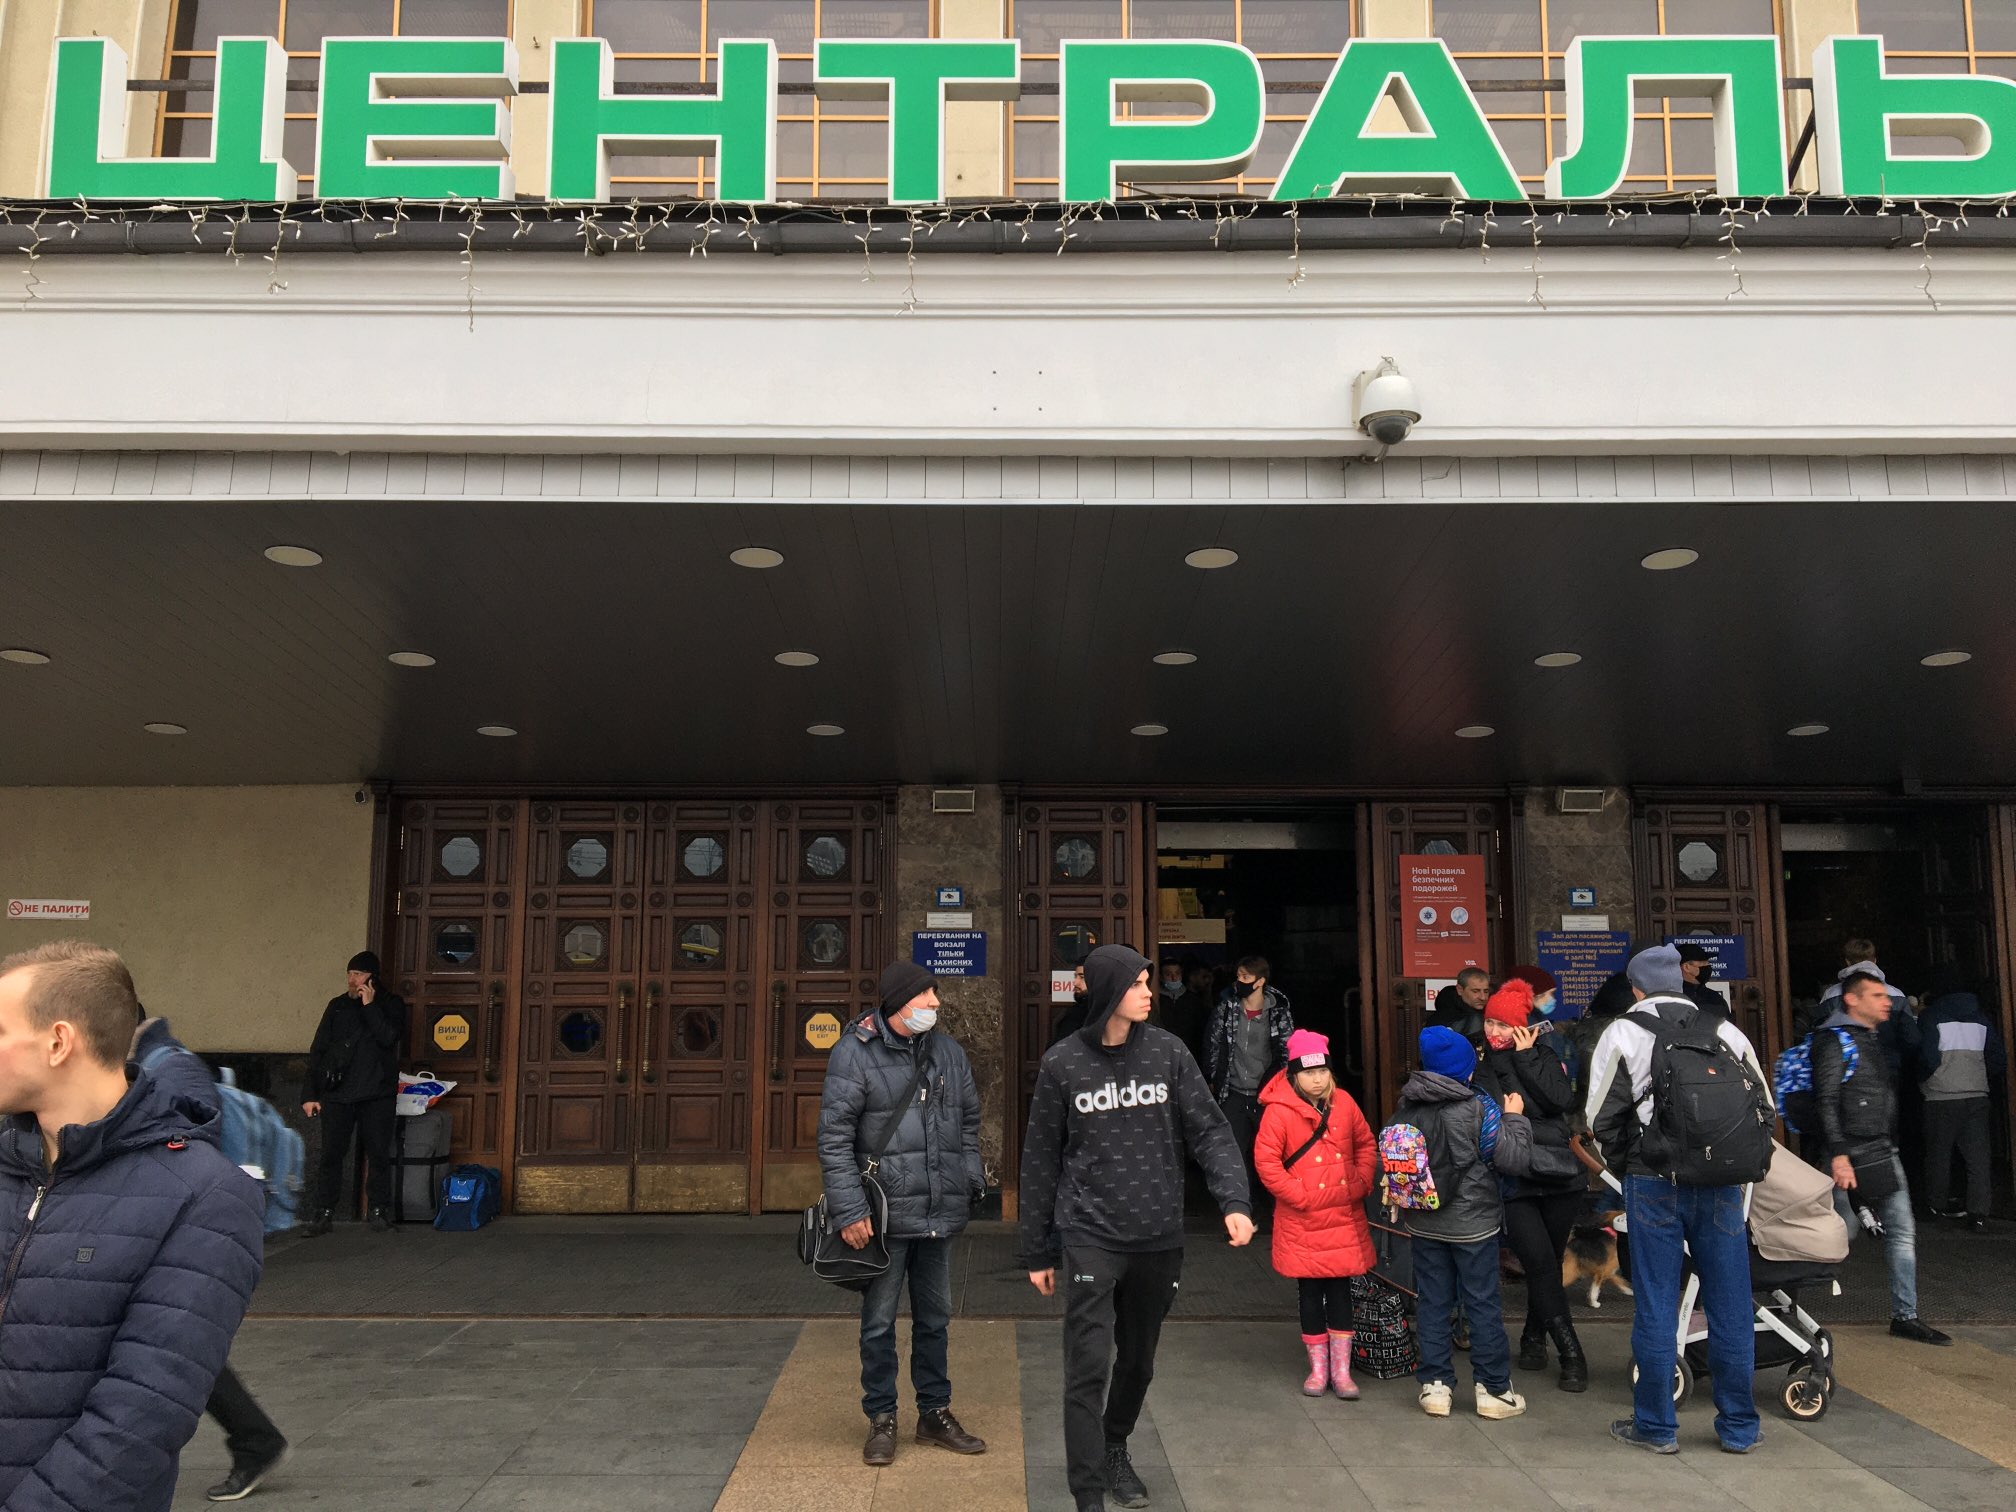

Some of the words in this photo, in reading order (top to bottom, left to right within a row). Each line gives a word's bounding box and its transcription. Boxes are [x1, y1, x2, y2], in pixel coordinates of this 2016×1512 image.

[50, 35, 2016, 206] ЦЕНТРАЛЬ
[1412, 867, 1430, 875] Нові
[1431, 868, 1466, 876] правила
[1412, 875, 1454, 883] безпечних
[1412, 885, 1458, 893] подорожей
[24, 905, 38, 913] НЕ
[42, 905, 89, 914] ПАЛИТИ
[438, 1026, 466, 1034] ВИХІД
[809, 1024, 837, 1032] ВИХІД
[1075, 1080, 1168, 1113] adidas
[1384, 1159, 1418, 1173] STARS
